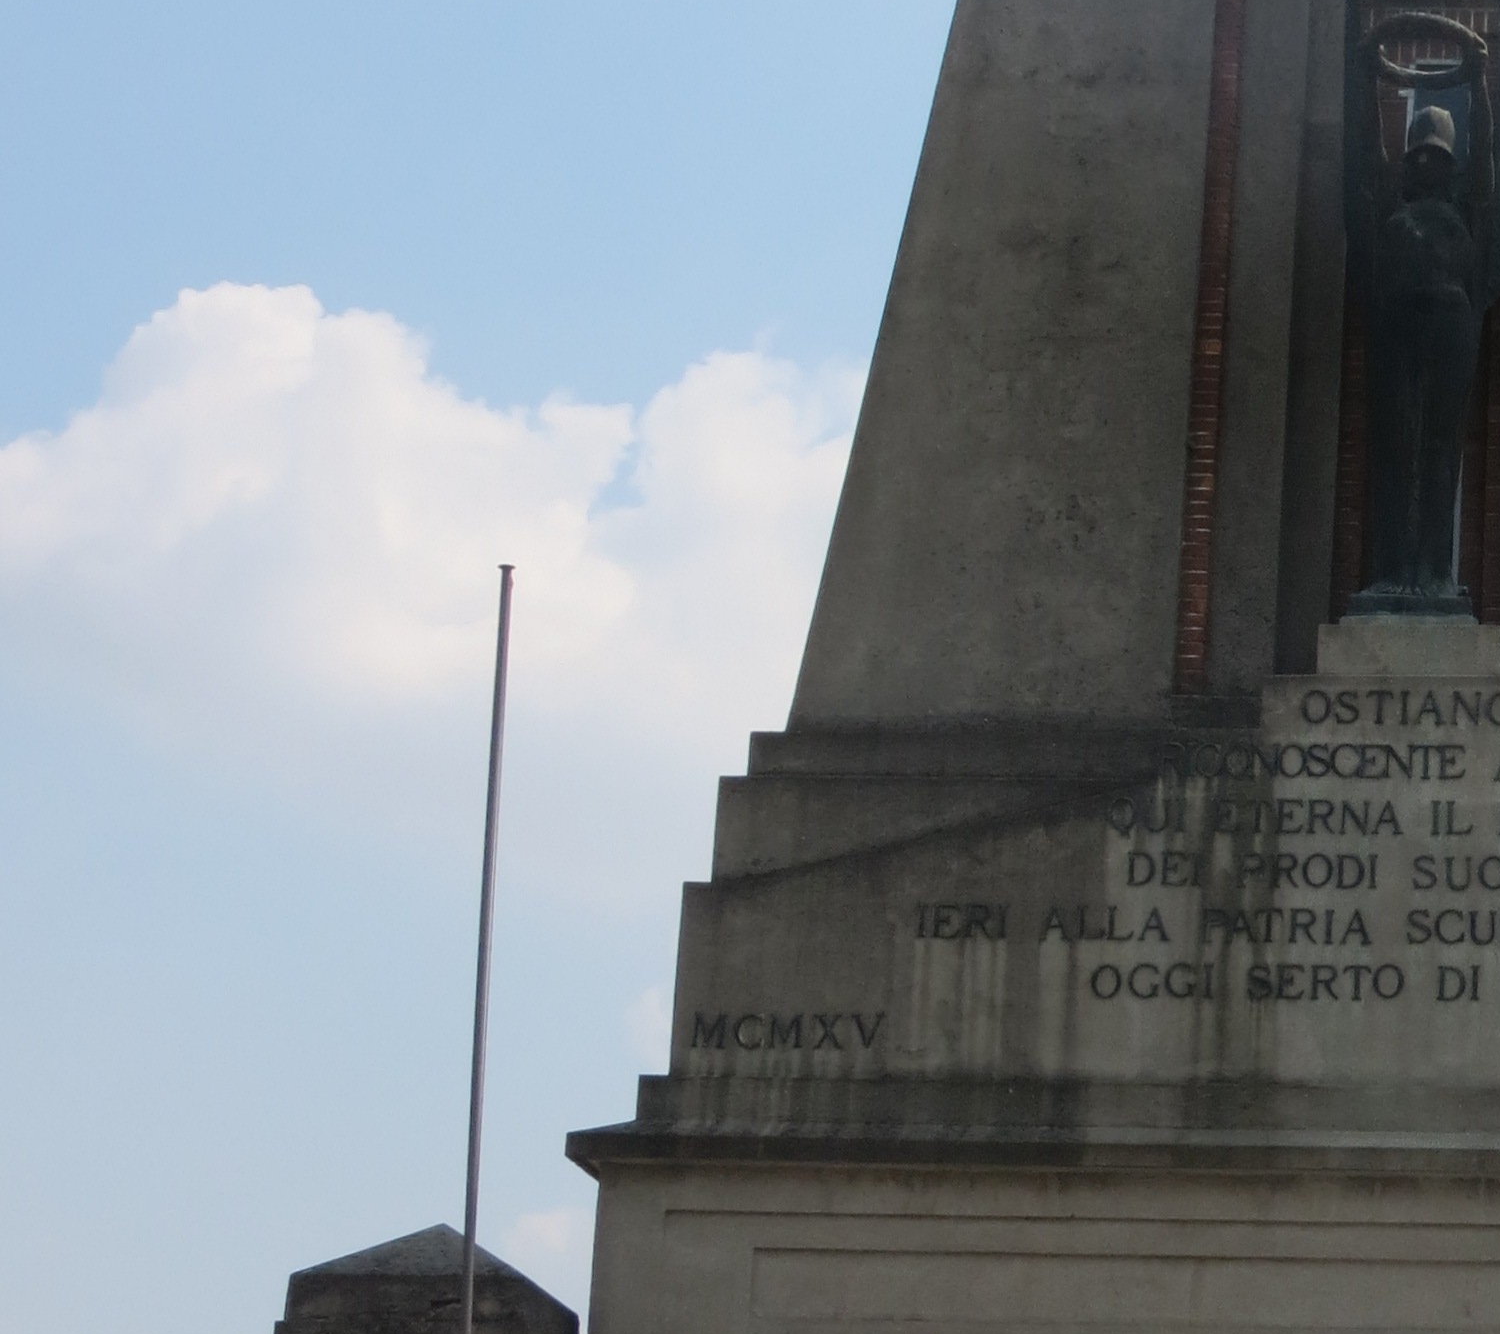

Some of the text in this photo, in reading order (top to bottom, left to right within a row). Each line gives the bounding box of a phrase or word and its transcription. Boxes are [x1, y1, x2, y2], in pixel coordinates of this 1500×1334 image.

[1160, 741, 1466, 781] RICONOSCENTE
[1109, 796, 1184, 840] QUI
[1216, 798, 1402, 836] ETERNA
[1430, 799, 1473, 837] IL
[1126, 851, 1204, 889] DEI
[1237, 852, 1379, 891] PRODI
[914, 902, 1010, 940] IERI
[1040, 906, 1171, 944] ALLA
[1202, 908, 1373, 946] PATRIA
[1090, 963, 1214, 1000] OGGI
[1246, 964, 1405, 1002] SERTO
[1436, 964, 1481, 1003] DI
[691, 1012, 886, 1051] MCMXV
